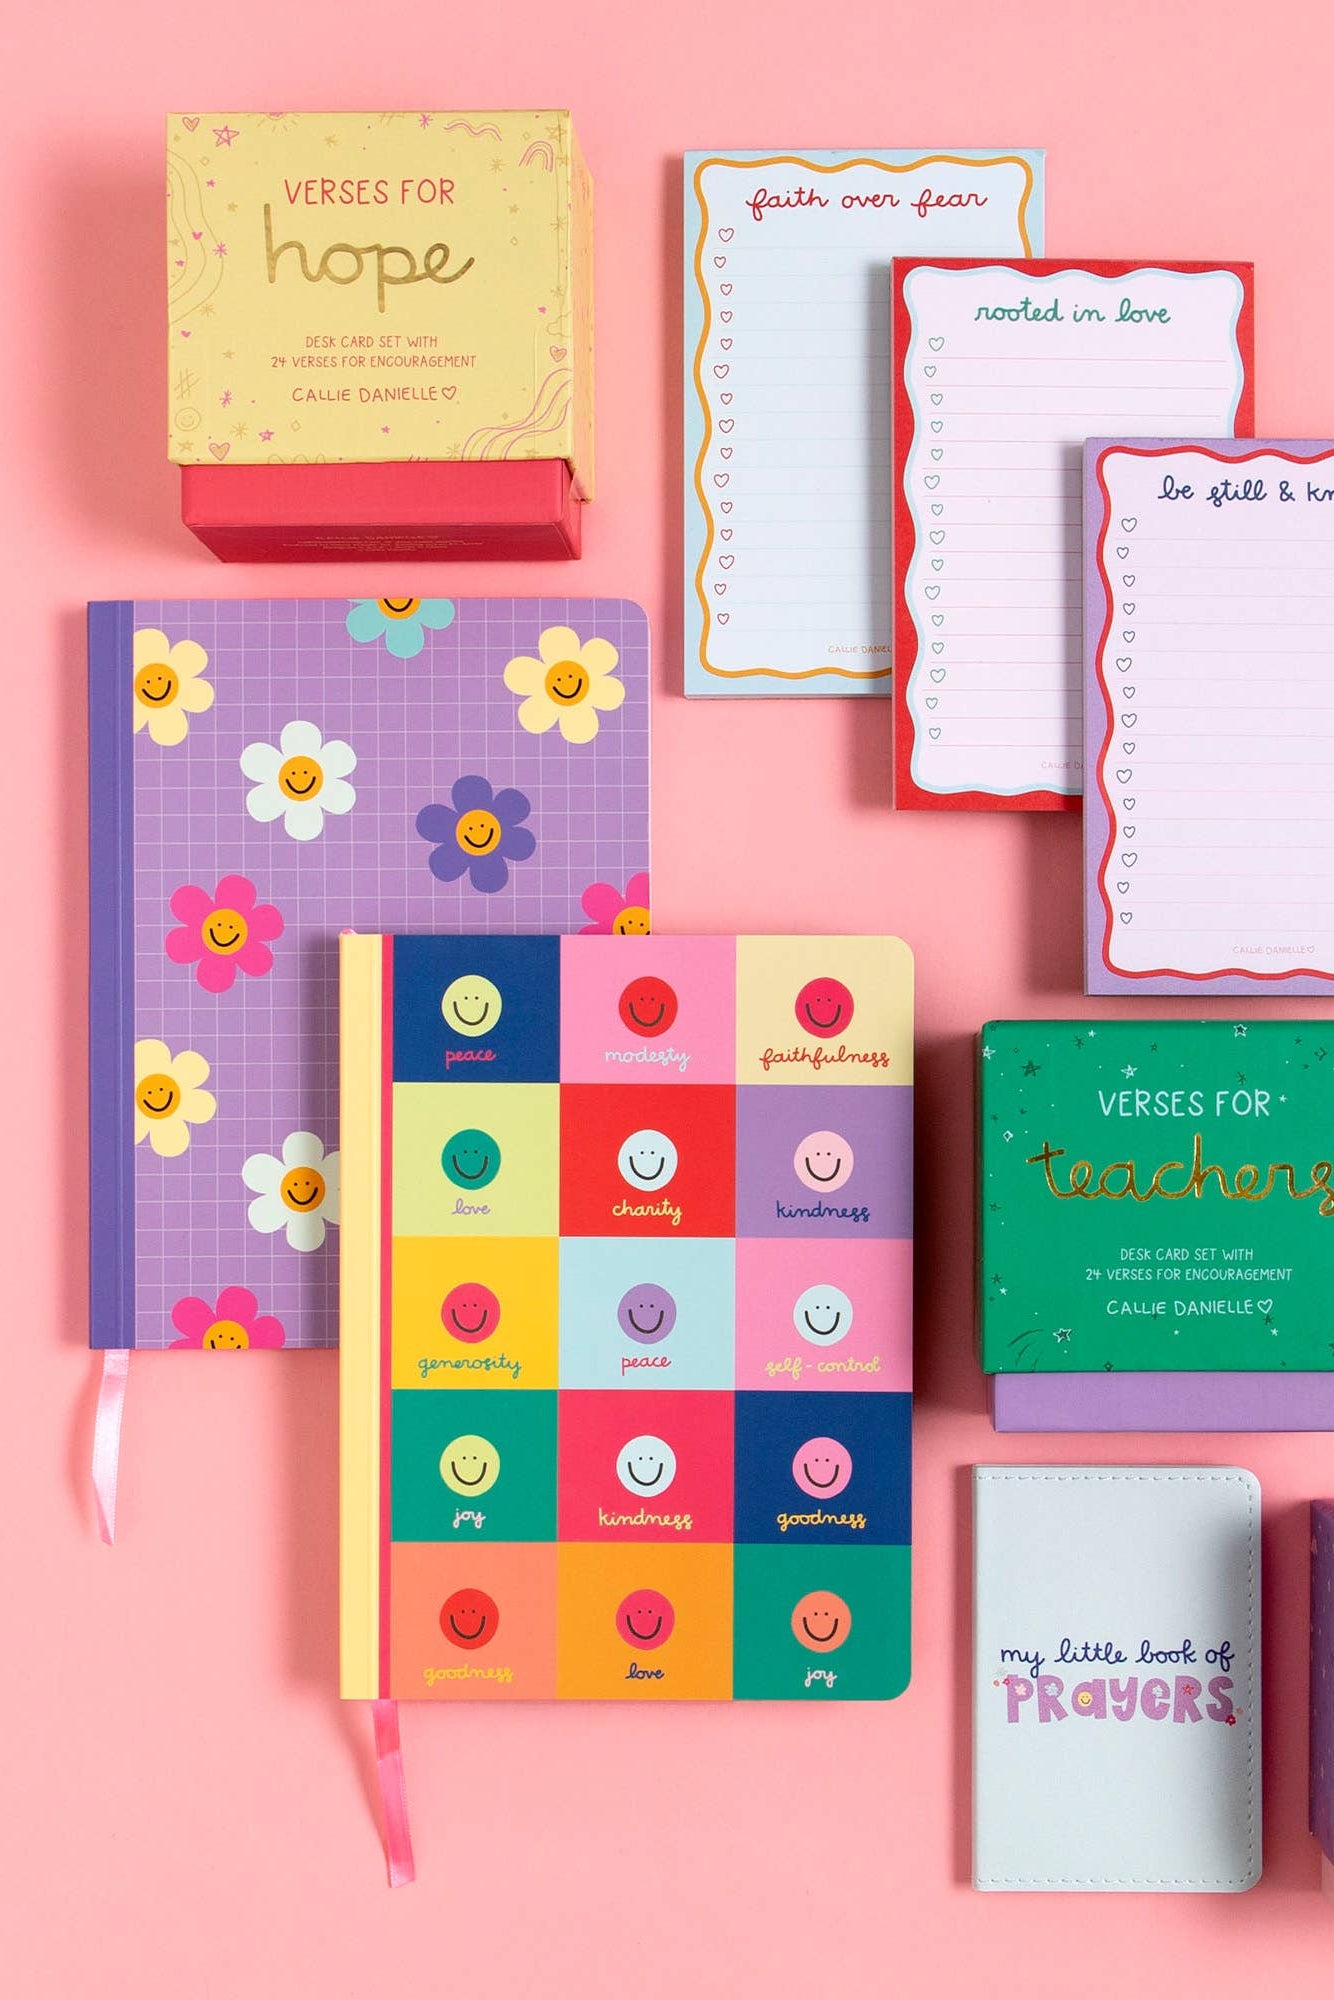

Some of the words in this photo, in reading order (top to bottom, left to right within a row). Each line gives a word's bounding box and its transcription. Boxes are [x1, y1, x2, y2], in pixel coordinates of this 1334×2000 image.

[285, 177, 388, 205] VERSES
[402, 178, 454, 204] FOR
[746, 187, 829, 221] faith
[842, 194, 900, 208] over
[911, 189, 988, 218] fear
[264, 203, 475, 313] hope
[974, 297, 1064, 322] rooted
[1073, 304, 1105, 322] in
[1115, 298, 1171, 323] love
[306, 336, 335, 348] DESK
[341, 336, 374, 348] CARD
[379, 336, 401, 348] SET
[407, 336, 437, 347] WITH
[271, 356, 286, 368] 24
[292, 356, 337, 368] VERSES
[342, 356, 365, 368] FOR
[371, 355, 476, 368] ENCOURAGEMENT
[293, 388, 350, 402] CALLIE
[359, 386, 437, 403] DANIELLE
[1158, 475, 1194, 500] be
[1206, 479, 1267, 507] still
[1280, 481, 1295, 502] &
[446, 1050, 496, 1069] peace
[605, 1047, 691, 1072] modesty
[759, 1045, 890, 1071] faithfulness
[1099, 1089, 1203, 1116] VERSES
[1217, 1089, 1270, 1117] FOR
[1026, 1132, 1334, 1215] teachers
[452, 1198, 491, 1215] love
[613, 1199, 682, 1225] charity
[777, 1200, 870, 1222] kindness
[1121, 1248, 1151, 1260] DESK
[1156, 1248, 1189, 1260] CARD
[1194, 1248, 1217, 1261] SET
[1222, 1249, 1253, 1260] WITH
[1086, 1269, 1101, 1280] 24
[1107, 1268, 1152, 1280] VERSES
[1157, 1268, 1181, 1280] FOR
[1186, 1268, 1292, 1280] ENCOURAGEMENT
[1107, 1300, 1166, 1315] CALLIE
[1175, 1299, 1253, 1316] DANIELLE
[418, 1353, 522, 1379] generosity
[622, 1357, 671, 1376] peace
[453, 1508, 486, 1528] joy
[599, 1508, 692, 1530] kindness
[777, 1509, 866, 1531] goodness
[1001, 1648, 1045, 1678] my
[1054, 1638, 1127, 1664] little
[1135, 1639, 1197, 1664] book
[1206, 1641, 1235, 1672] of
[424, 1664, 513, 1685] goodness
[625, 1662, 664, 1679] love
[805, 1667, 837, 1687] joy
